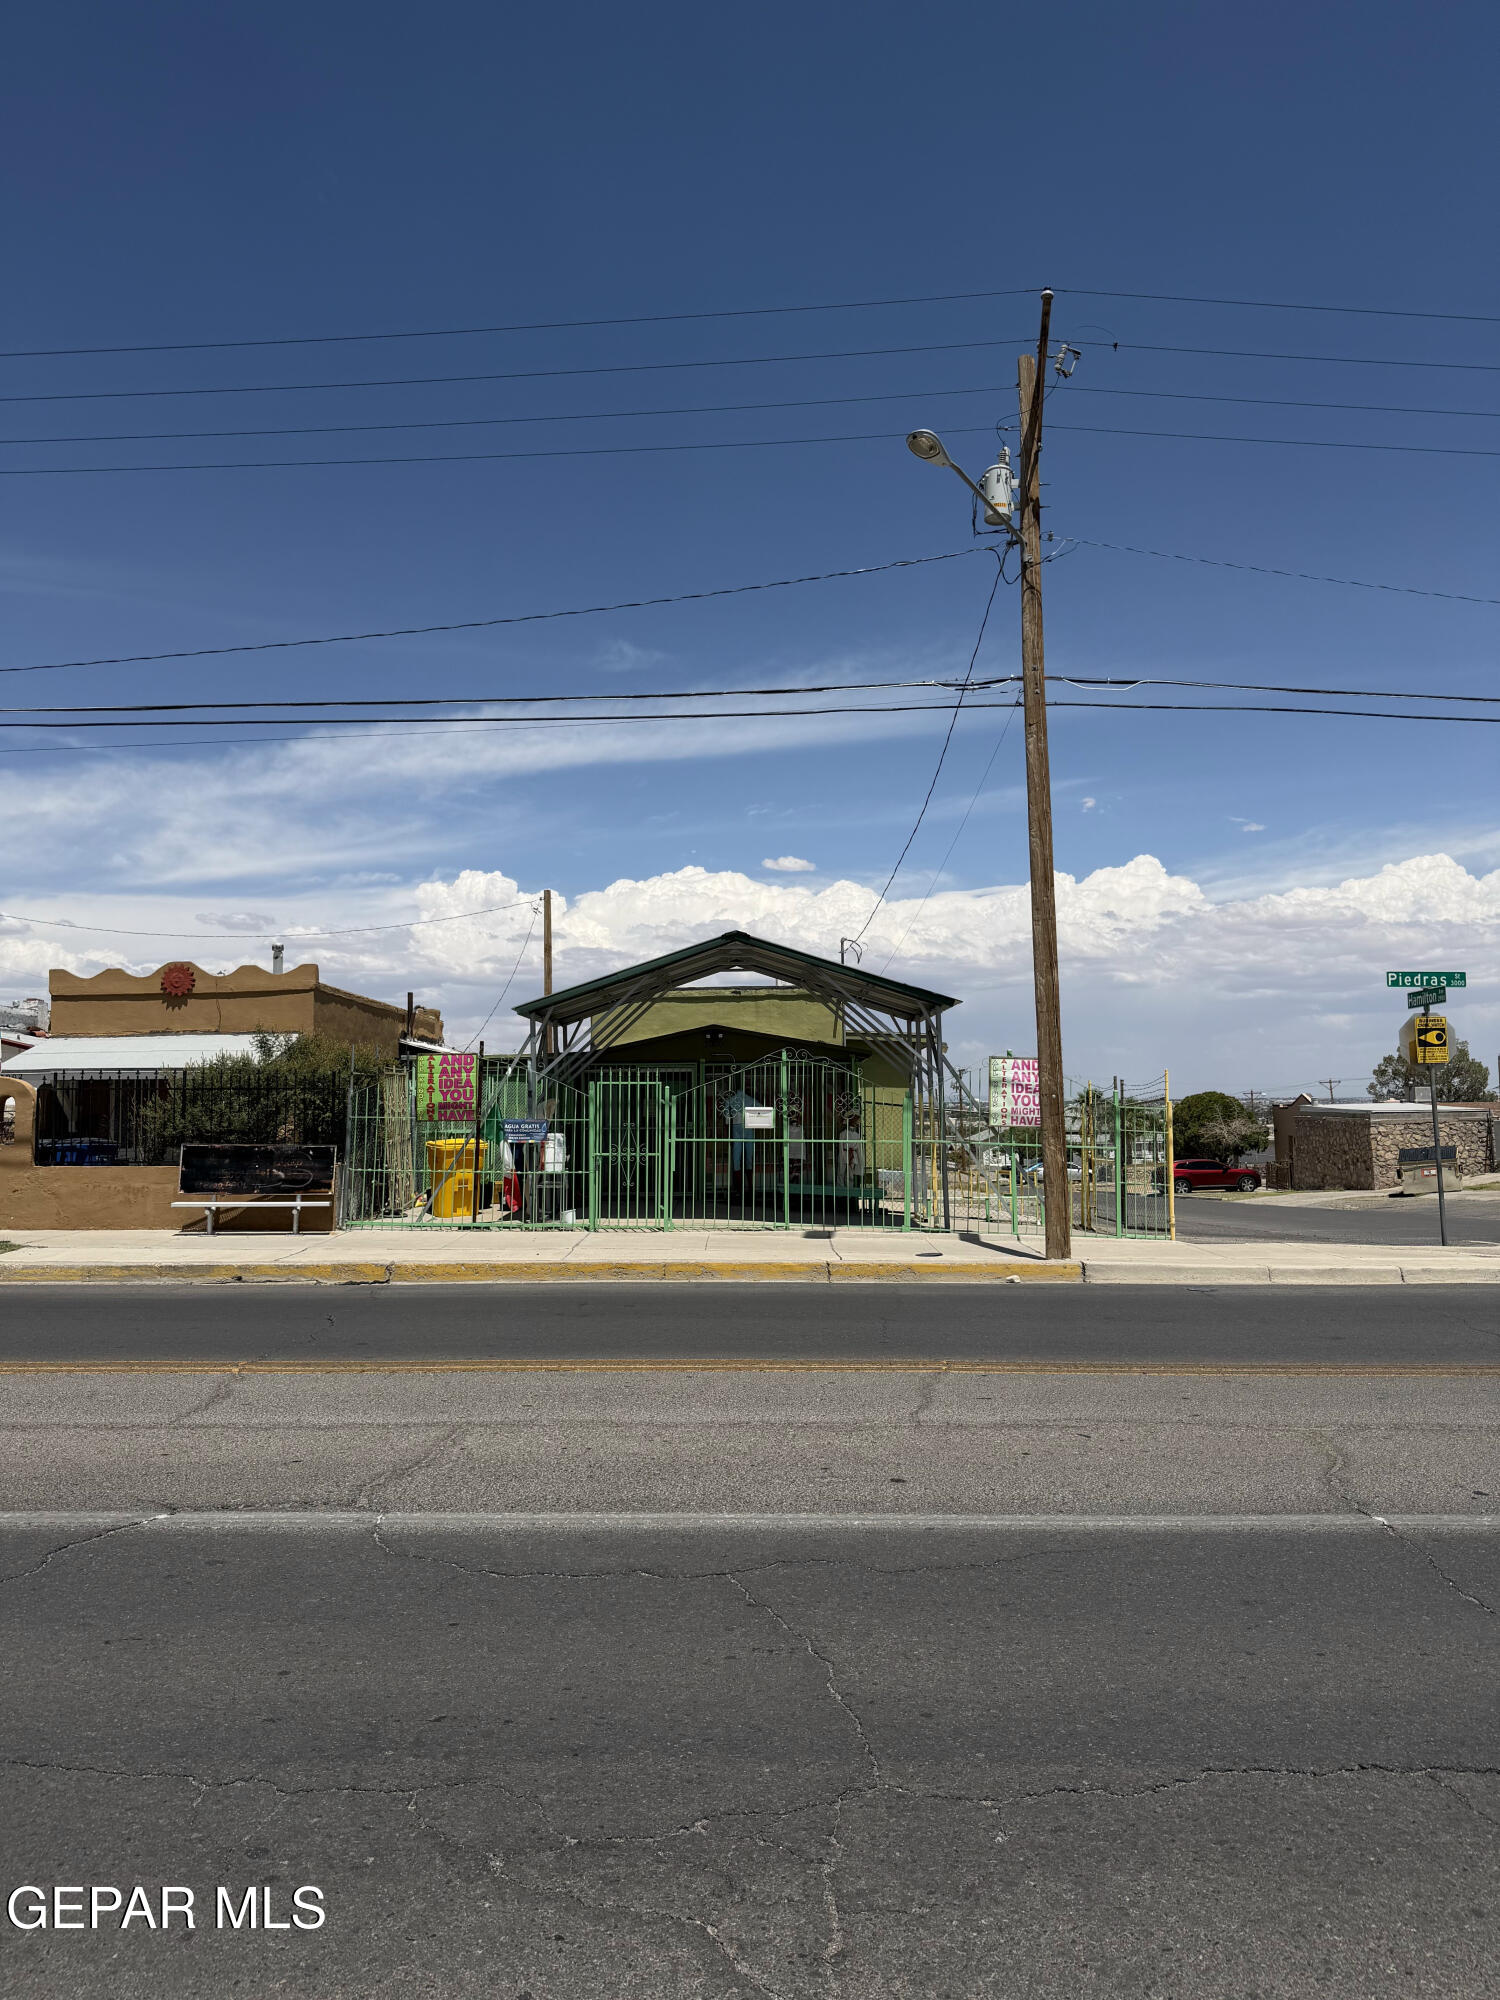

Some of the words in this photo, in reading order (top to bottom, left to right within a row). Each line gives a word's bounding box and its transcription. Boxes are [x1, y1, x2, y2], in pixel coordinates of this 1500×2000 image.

[1388, 972, 1447, 986] Piedras
[1408, 991, 1438, 1008] Hamilton
[439, 1054, 475, 1066] AND
[1011, 1059, 1039, 1070] AND
[438, 1066, 475, 1078] ANY
[1011, 1072, 1040, 1082] ANY
[426, 1055, 435, 1121] ALTERATIONS
[438, 1078, 474, 1089] IDEA
[1011, 1083, 1040, 1094] IDEA
[439, 1088, 475, 1101] YOU
[438, 1101, 475, 1110] MIGHT
[1011, 1095, 1040, 1107] YOU
[438, 1110, 476, 1121] HAVE
[1010, 1107, 1041, 1115] MIGHT
[1010, 1116, 1041, 1126] HAVE
